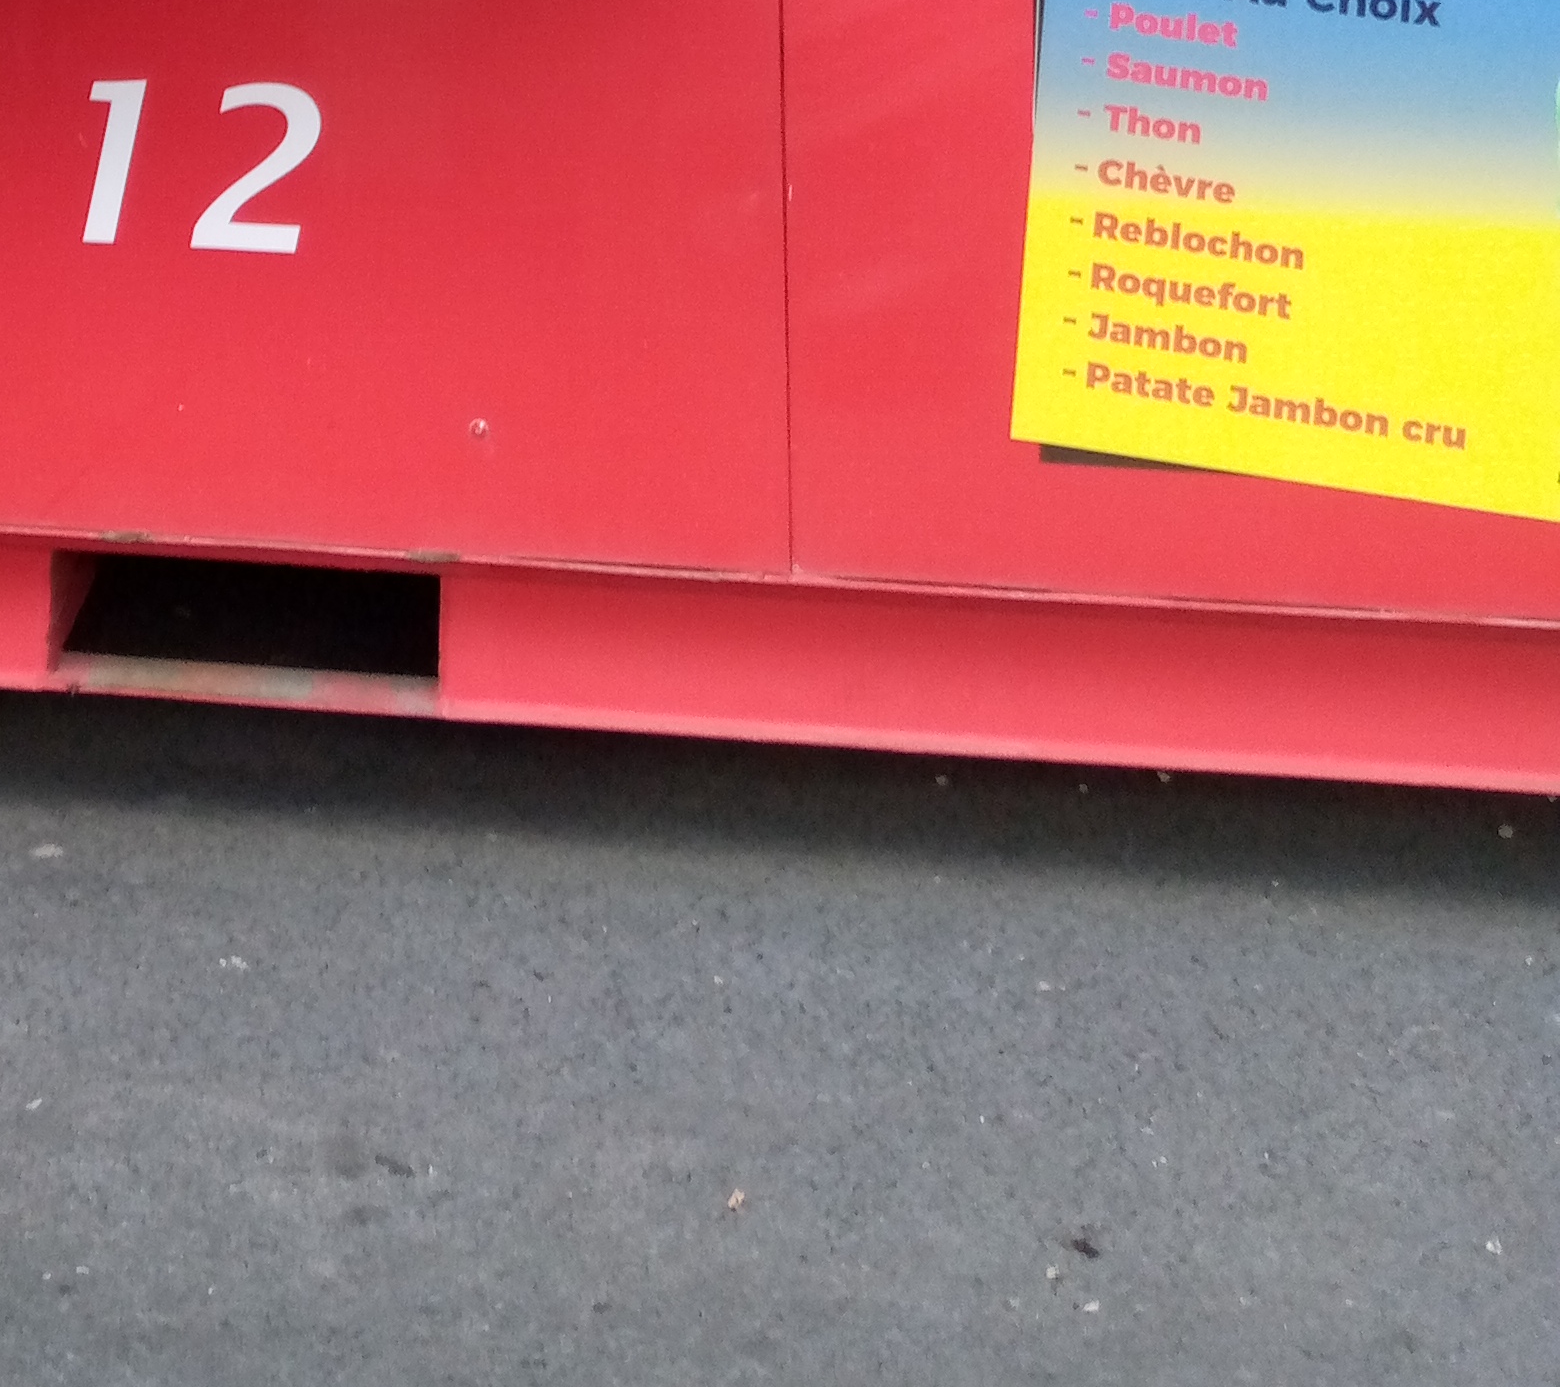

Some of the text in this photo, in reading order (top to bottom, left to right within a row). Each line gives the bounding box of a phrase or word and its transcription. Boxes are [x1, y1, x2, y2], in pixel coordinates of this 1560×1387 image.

[1108, 0, 1238, 49] Poulet
[1105, 51, 1269, 103] Saumon
[1103, 103, 1202, 145] Thon
[82, 78, 322, 254] 12
[1097, 158, 1237, 204] Chèvre
[1092, 210, 1306, 271] Reblochon
[1090, 261, 1293, 321] Roquefort
[1088, 311, 1249, 364] Jambon
[1086, 361, 1467, 451] Patate Jambon cru
